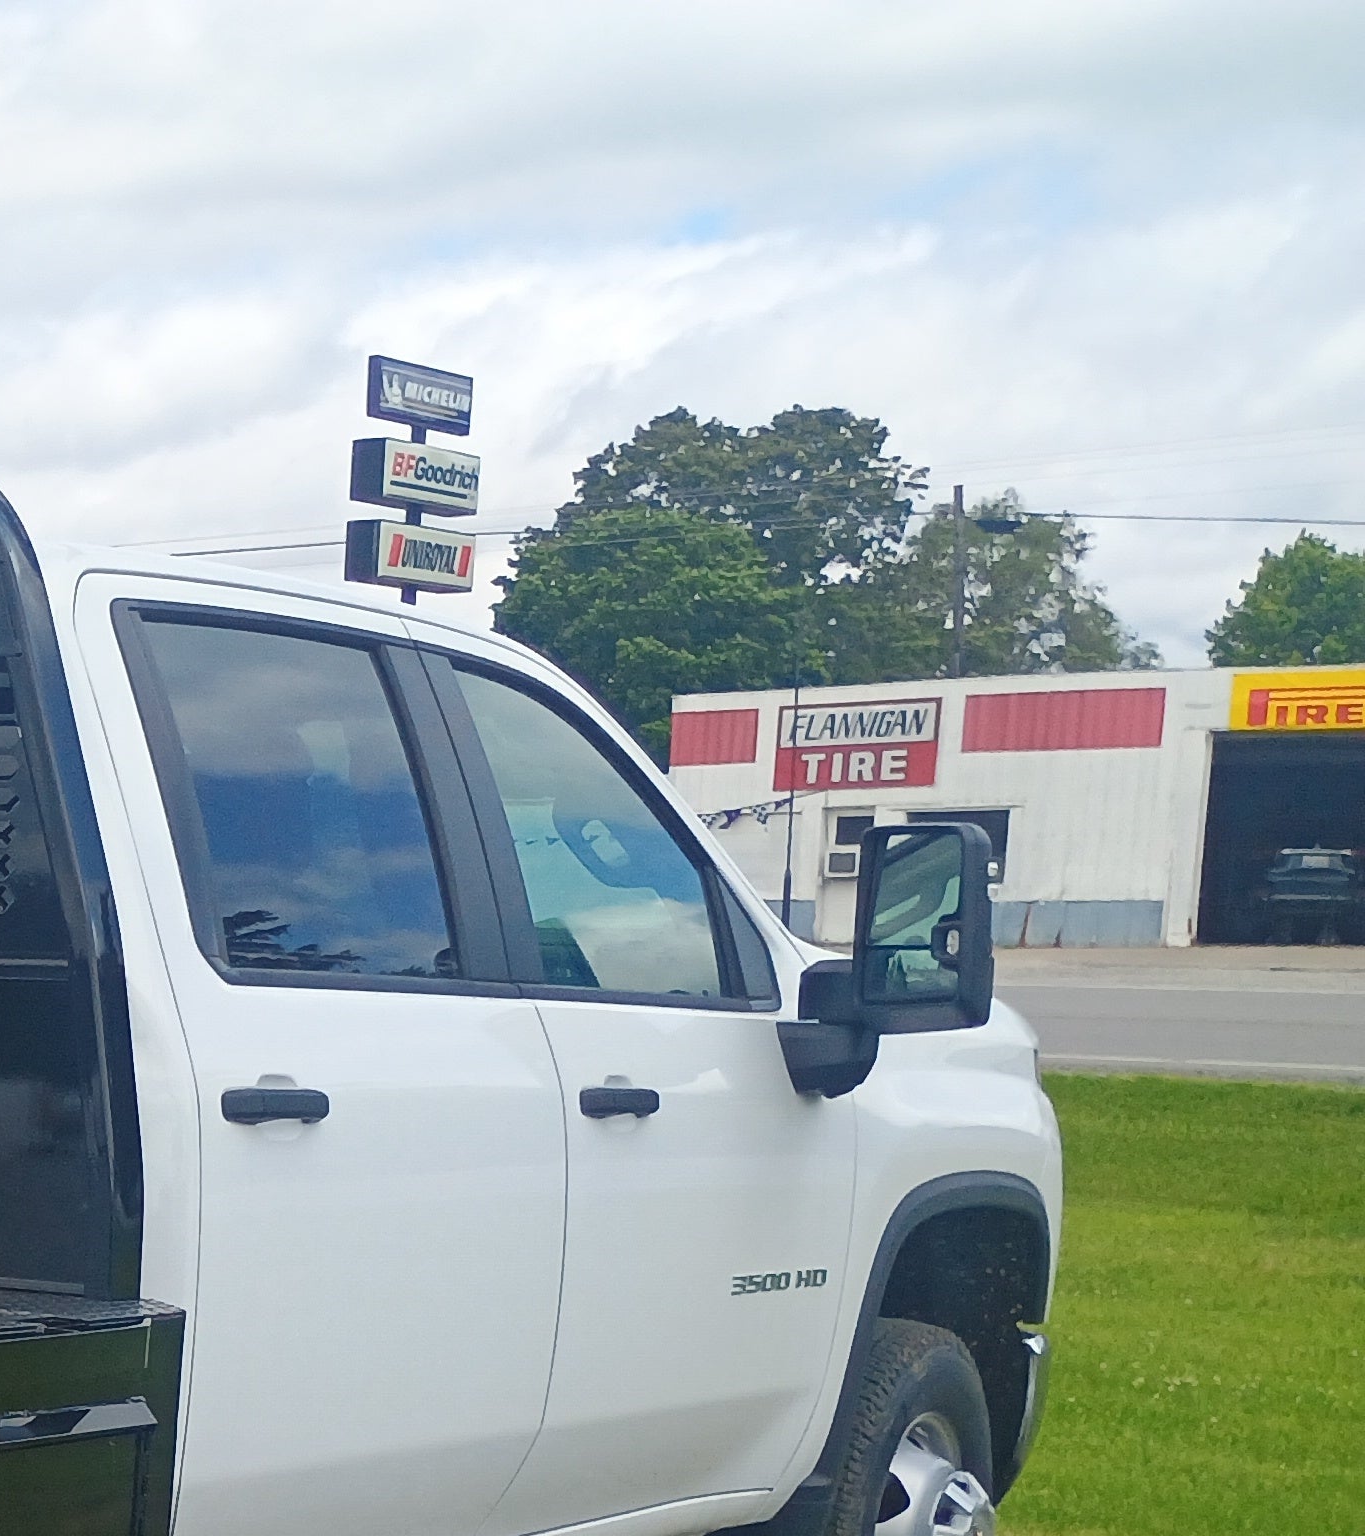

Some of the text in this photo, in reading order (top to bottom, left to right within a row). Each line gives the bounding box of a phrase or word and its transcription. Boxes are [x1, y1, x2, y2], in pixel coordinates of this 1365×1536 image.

[404, 381, 472, 412] MICHELIN
[391, 452, 479, 491] BFGoodrich
[787, 708, 929, 741] FLANNIGAN
[801, 750, 909, 784] TIRE
[731, 1268, 828, 1296] 3500 HD
